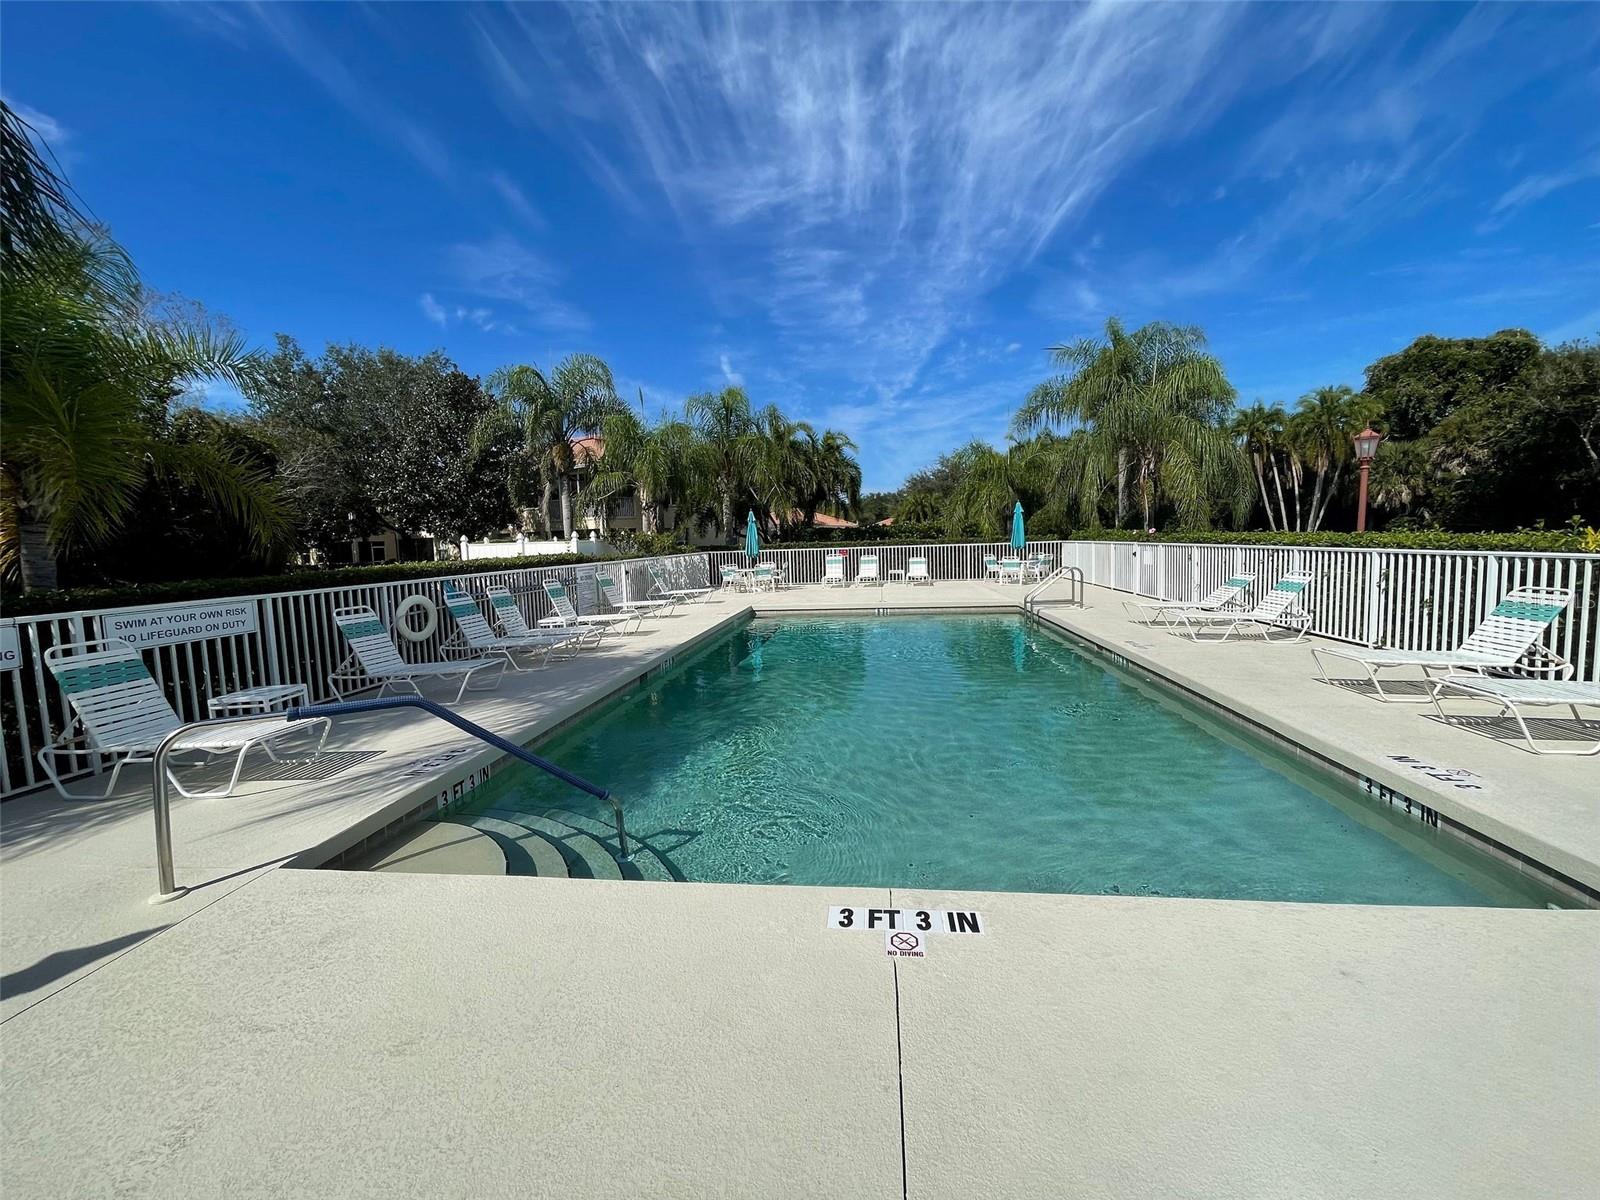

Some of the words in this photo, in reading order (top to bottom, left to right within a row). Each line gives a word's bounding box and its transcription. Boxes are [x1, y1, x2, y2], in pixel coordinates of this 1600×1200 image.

[114, 619, 147, 630] SWIM
[150, 616, 163, 626] AT
[166, 613, 197, 623] YOUR
[200, 609, 223, 620] OWN
[226, 607, 247, 617] RISK
[140, 625, 202, 641] LIFEGUARD
[205, 623, 219, 632] ON
[222, 619, 246, 630] DUTY
[441, 790, 449, 806] 3
[453, 780, 465, 800] FT
[469, 774, 475, 789] 3
[480, 765, 490, 783] IN
[1365, 777, 1373, 793] 3
[1380, 784, 1396, 805] FT
[1403, 796, 1412, 814] 3
[1420, 805, 1440, 828] IN
[838, 908, 854, 928] 3
[868, 909, 900, 930] FT
[915, 911, 932, 931] 3
[947, 912, 981, 933] IN
